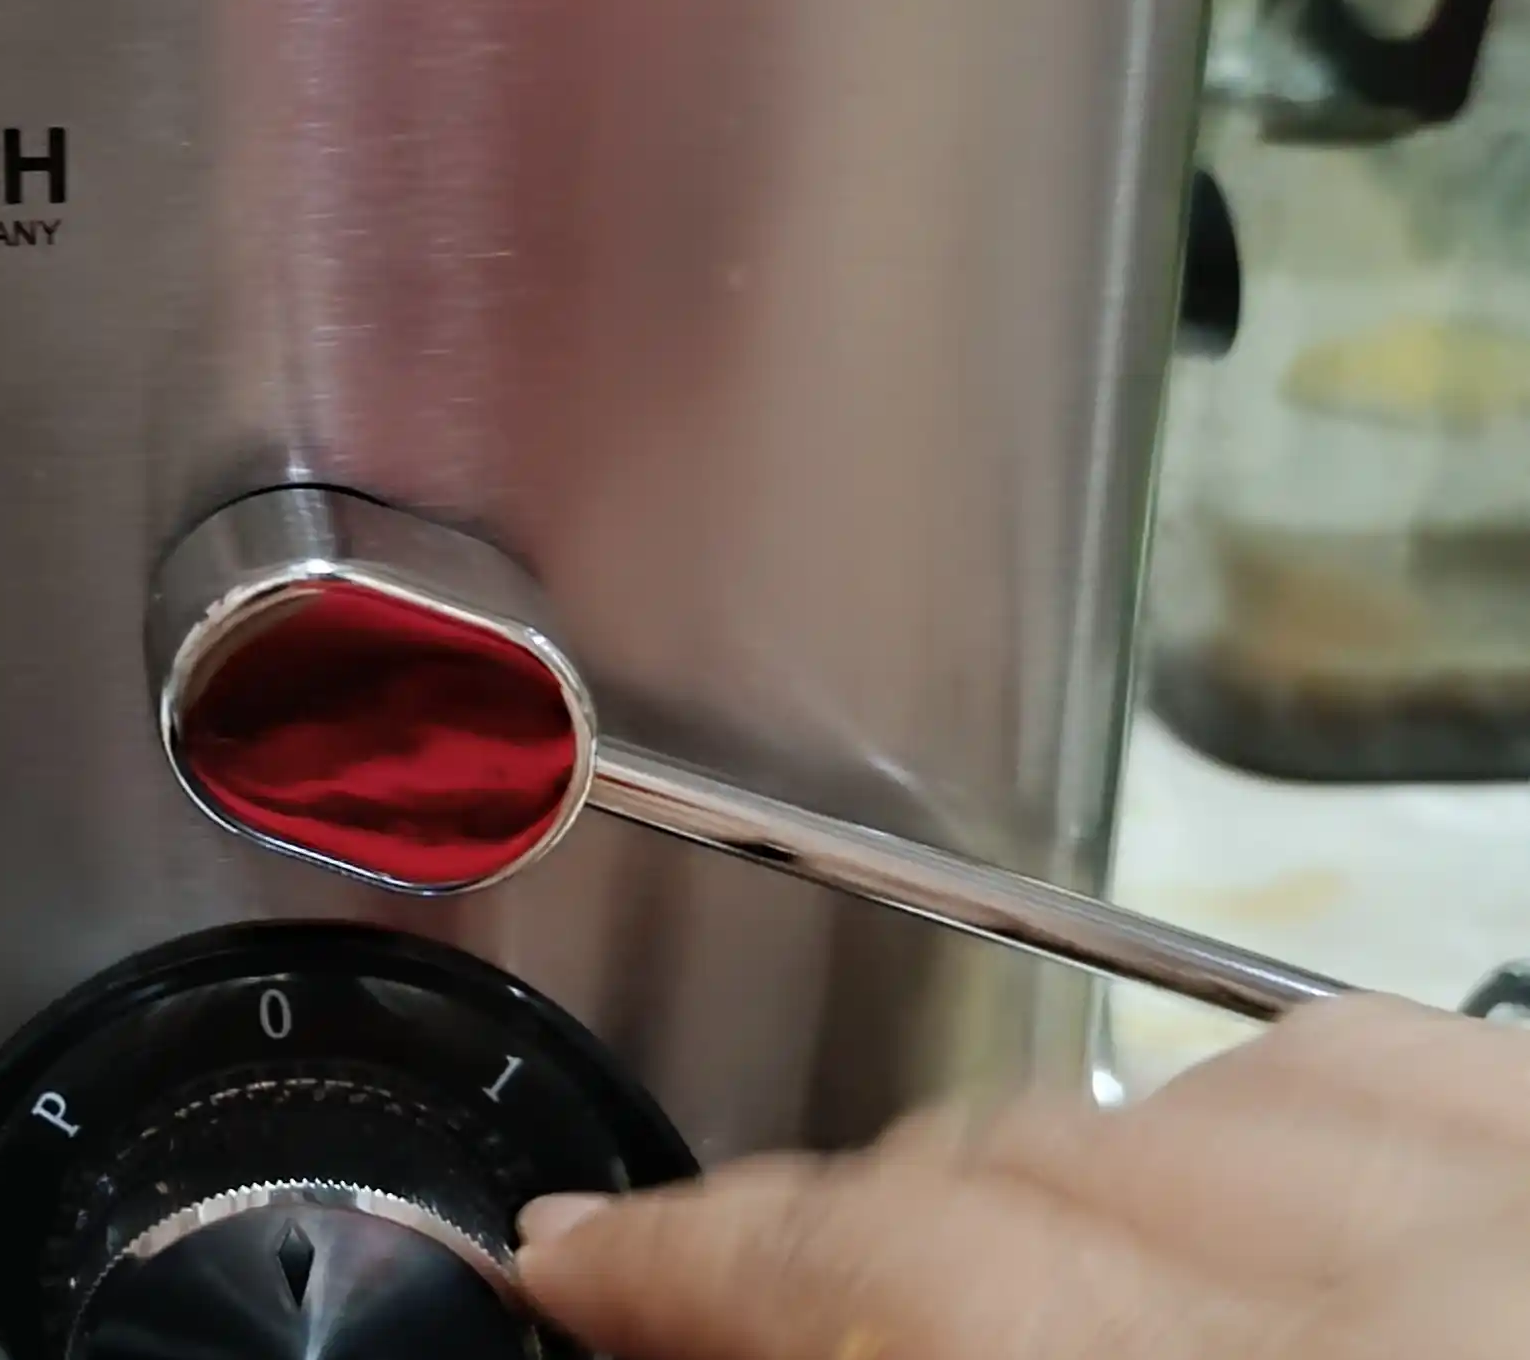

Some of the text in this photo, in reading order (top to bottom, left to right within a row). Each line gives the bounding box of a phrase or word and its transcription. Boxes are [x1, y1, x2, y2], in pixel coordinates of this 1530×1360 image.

[259, 988, 292, 1039] 0
[482, 1054, 522, 1103] 1
[31, 1090, 81, 1138] P
